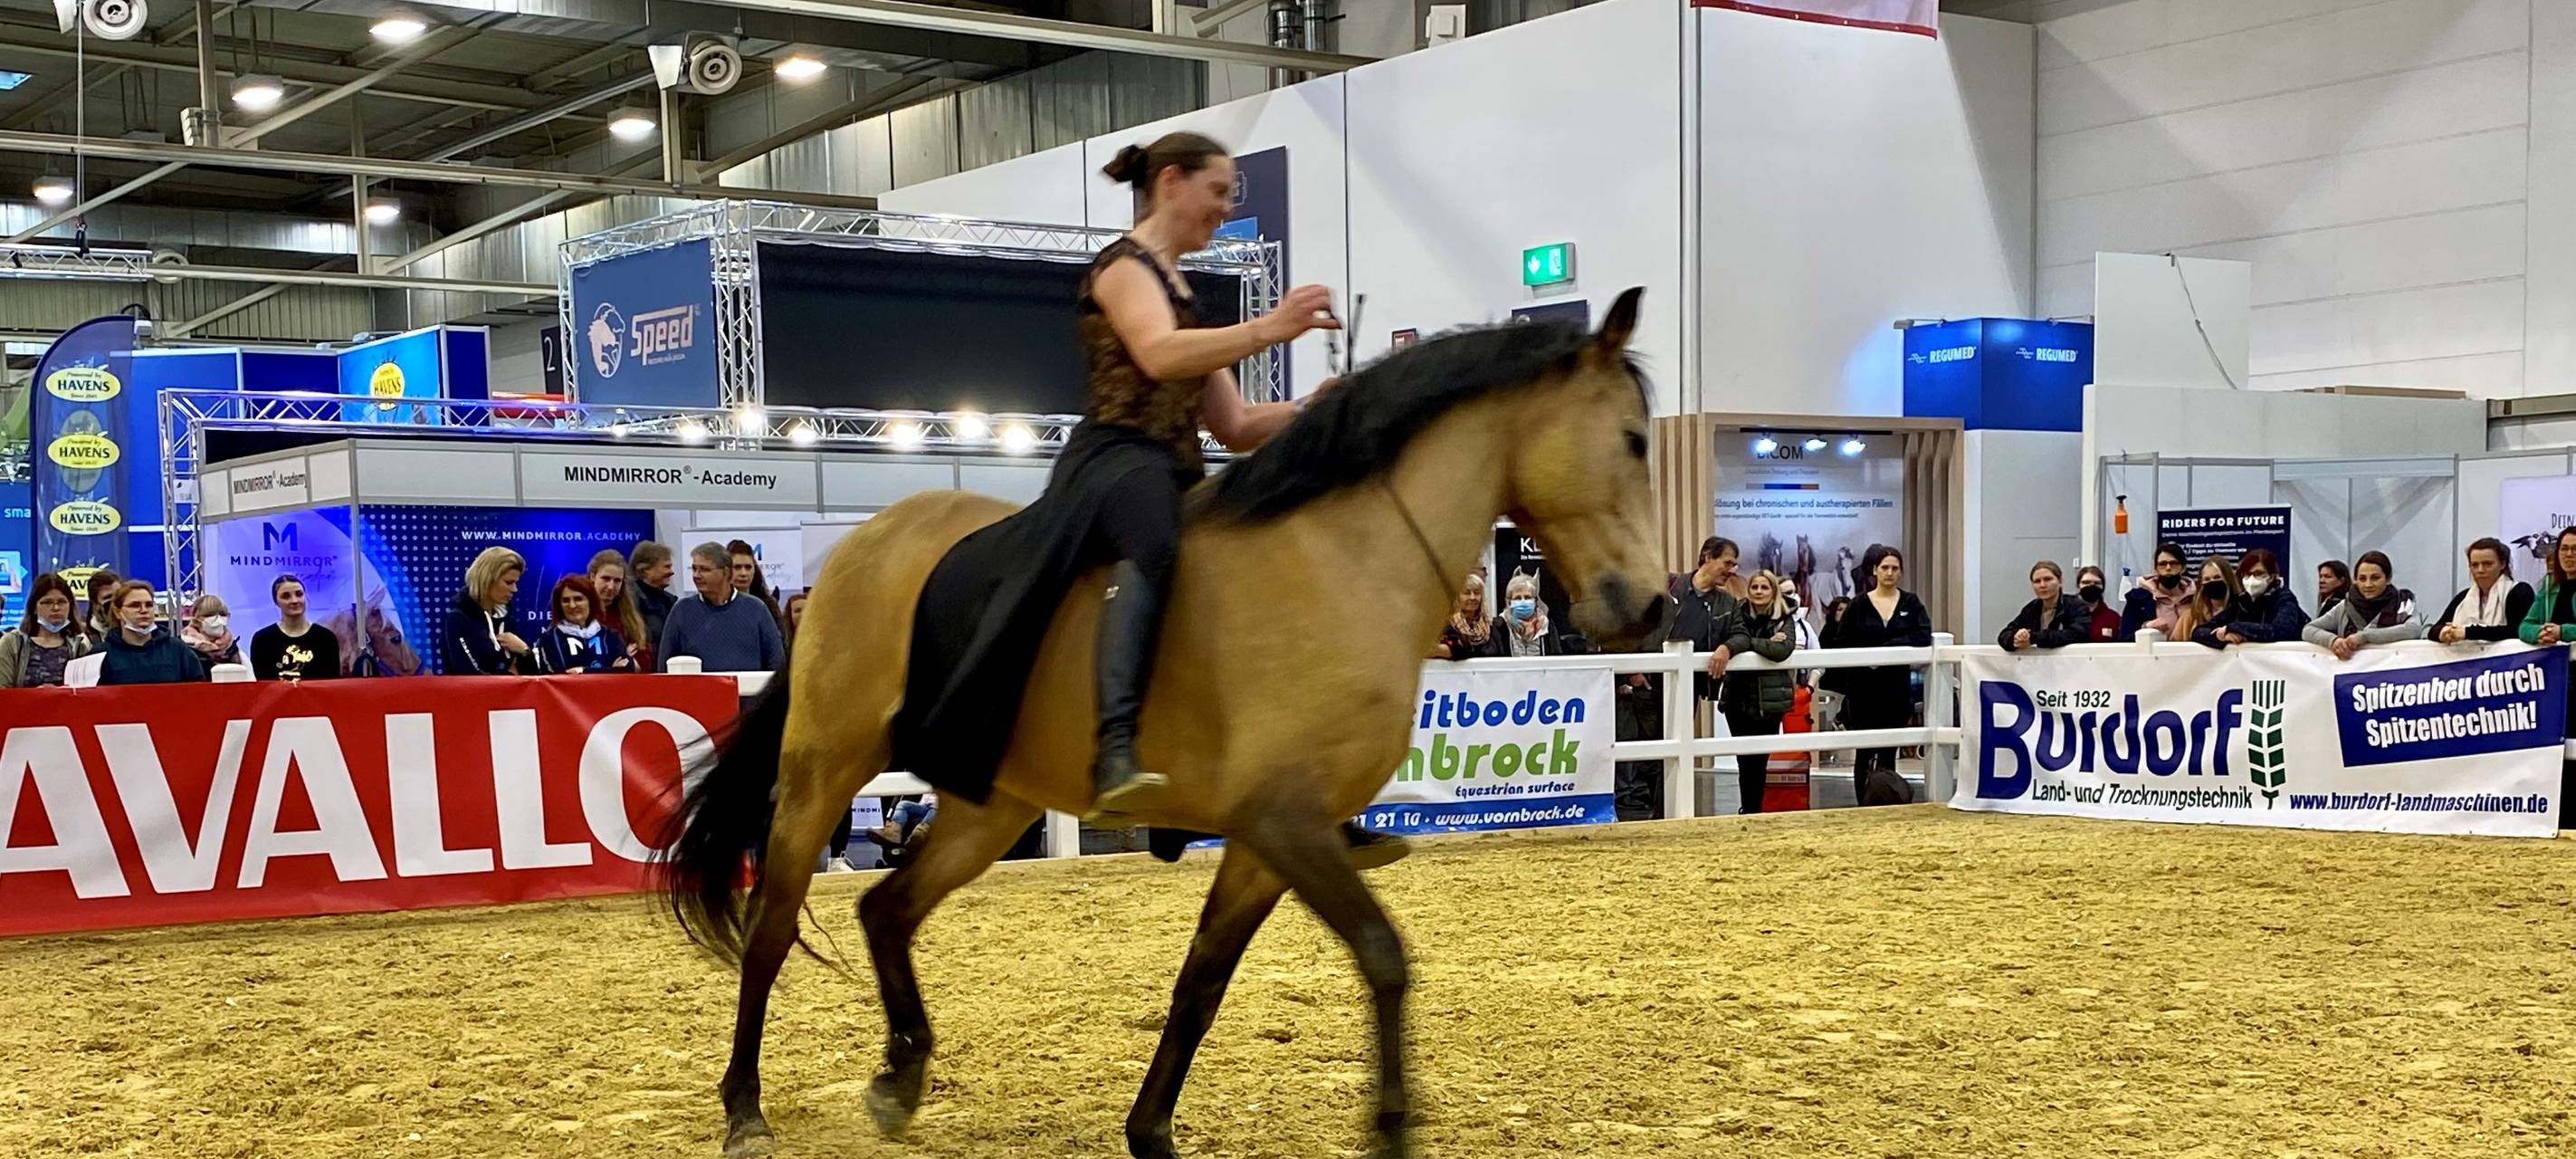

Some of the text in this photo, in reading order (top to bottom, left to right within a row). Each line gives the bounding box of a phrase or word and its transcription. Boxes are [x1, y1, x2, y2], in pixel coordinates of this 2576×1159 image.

[631, 304, 693, 366] Speed
[58, 379, 110, 392] HAVENS
[59, 446, 110, 459] HAVENS
[60, 513, 110, 525] HAVENS
[2161, 515, 2285, 529] RIDERS FOR FUTURE
[462, 531, 641, 541] WWW.MINDMIRROR.ACADEMY
[2037, 690, 2111, 708] Seit 1932
[2352, 664, 2545, 713] Spitzenheu durch
[1419, 689, 1586, 730] itboden
[2365, 701, 2537, 748] Spitzentechnik!
[1976, 680, 2243, 800] Burdorf
[1455, 781, 1575, 800] Equestrian surface
[2032, 780, 2253, 810] Land- und Trocknungstechnik
[2289, 792, 2548, 813] www.burdorf-landmaschinen.de
[1375, 812, 1396, 829] 21
[1435, 805, 1585, 826] www.vornbrock.de
